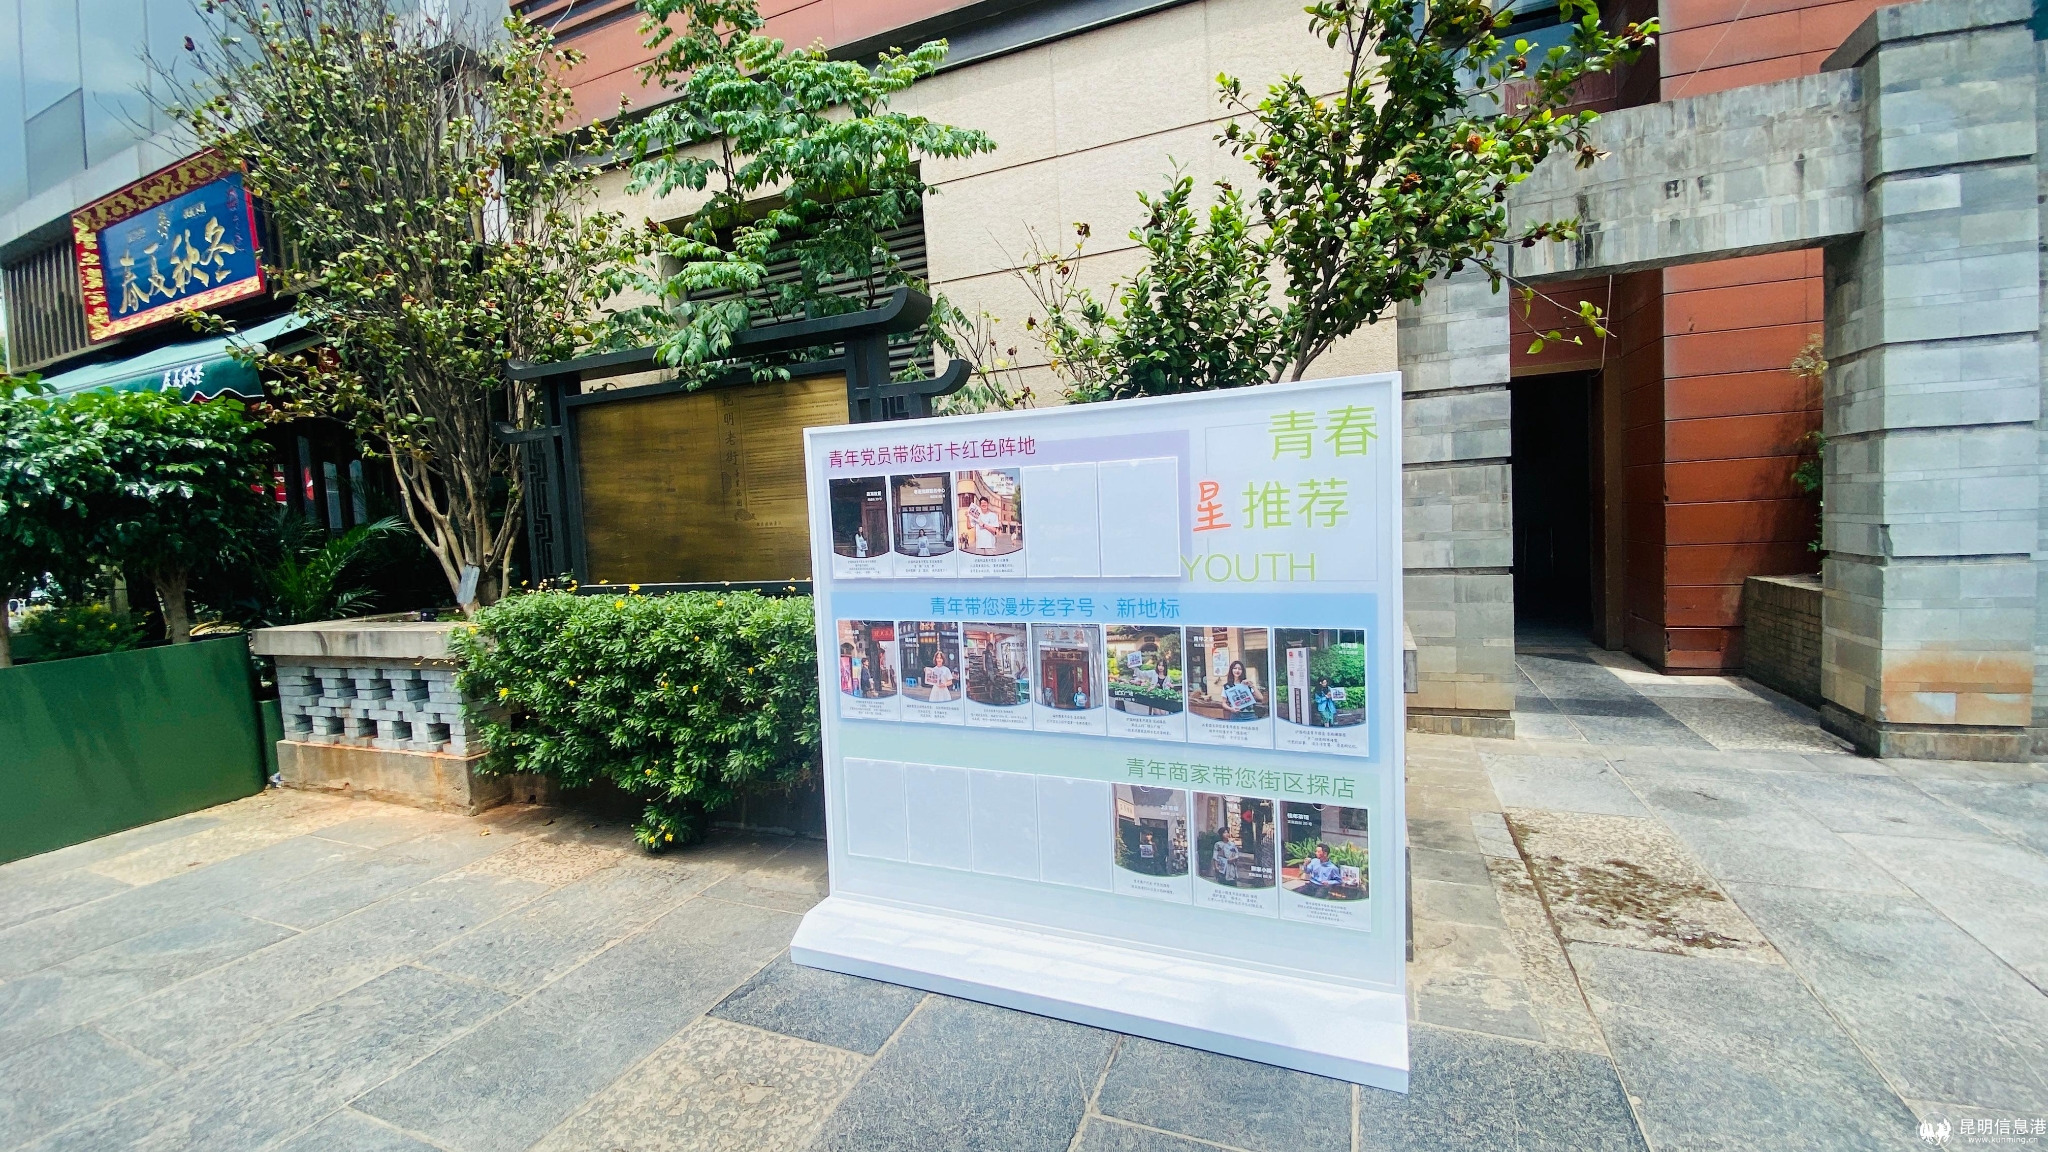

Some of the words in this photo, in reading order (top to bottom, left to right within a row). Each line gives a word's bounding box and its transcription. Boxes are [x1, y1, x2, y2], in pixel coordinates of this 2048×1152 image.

[1267, 405, 1379, 461] 青春
[828, 435, 1036, 469] 青年党员带您打卡红色阵地
[1180, 552, 1316, 583] YOUTH
[930, 596, 1180, 618] 青年带您漫步老字号、新地标
[1126, 758, 1356, 799] 青年商家带您街区探店
